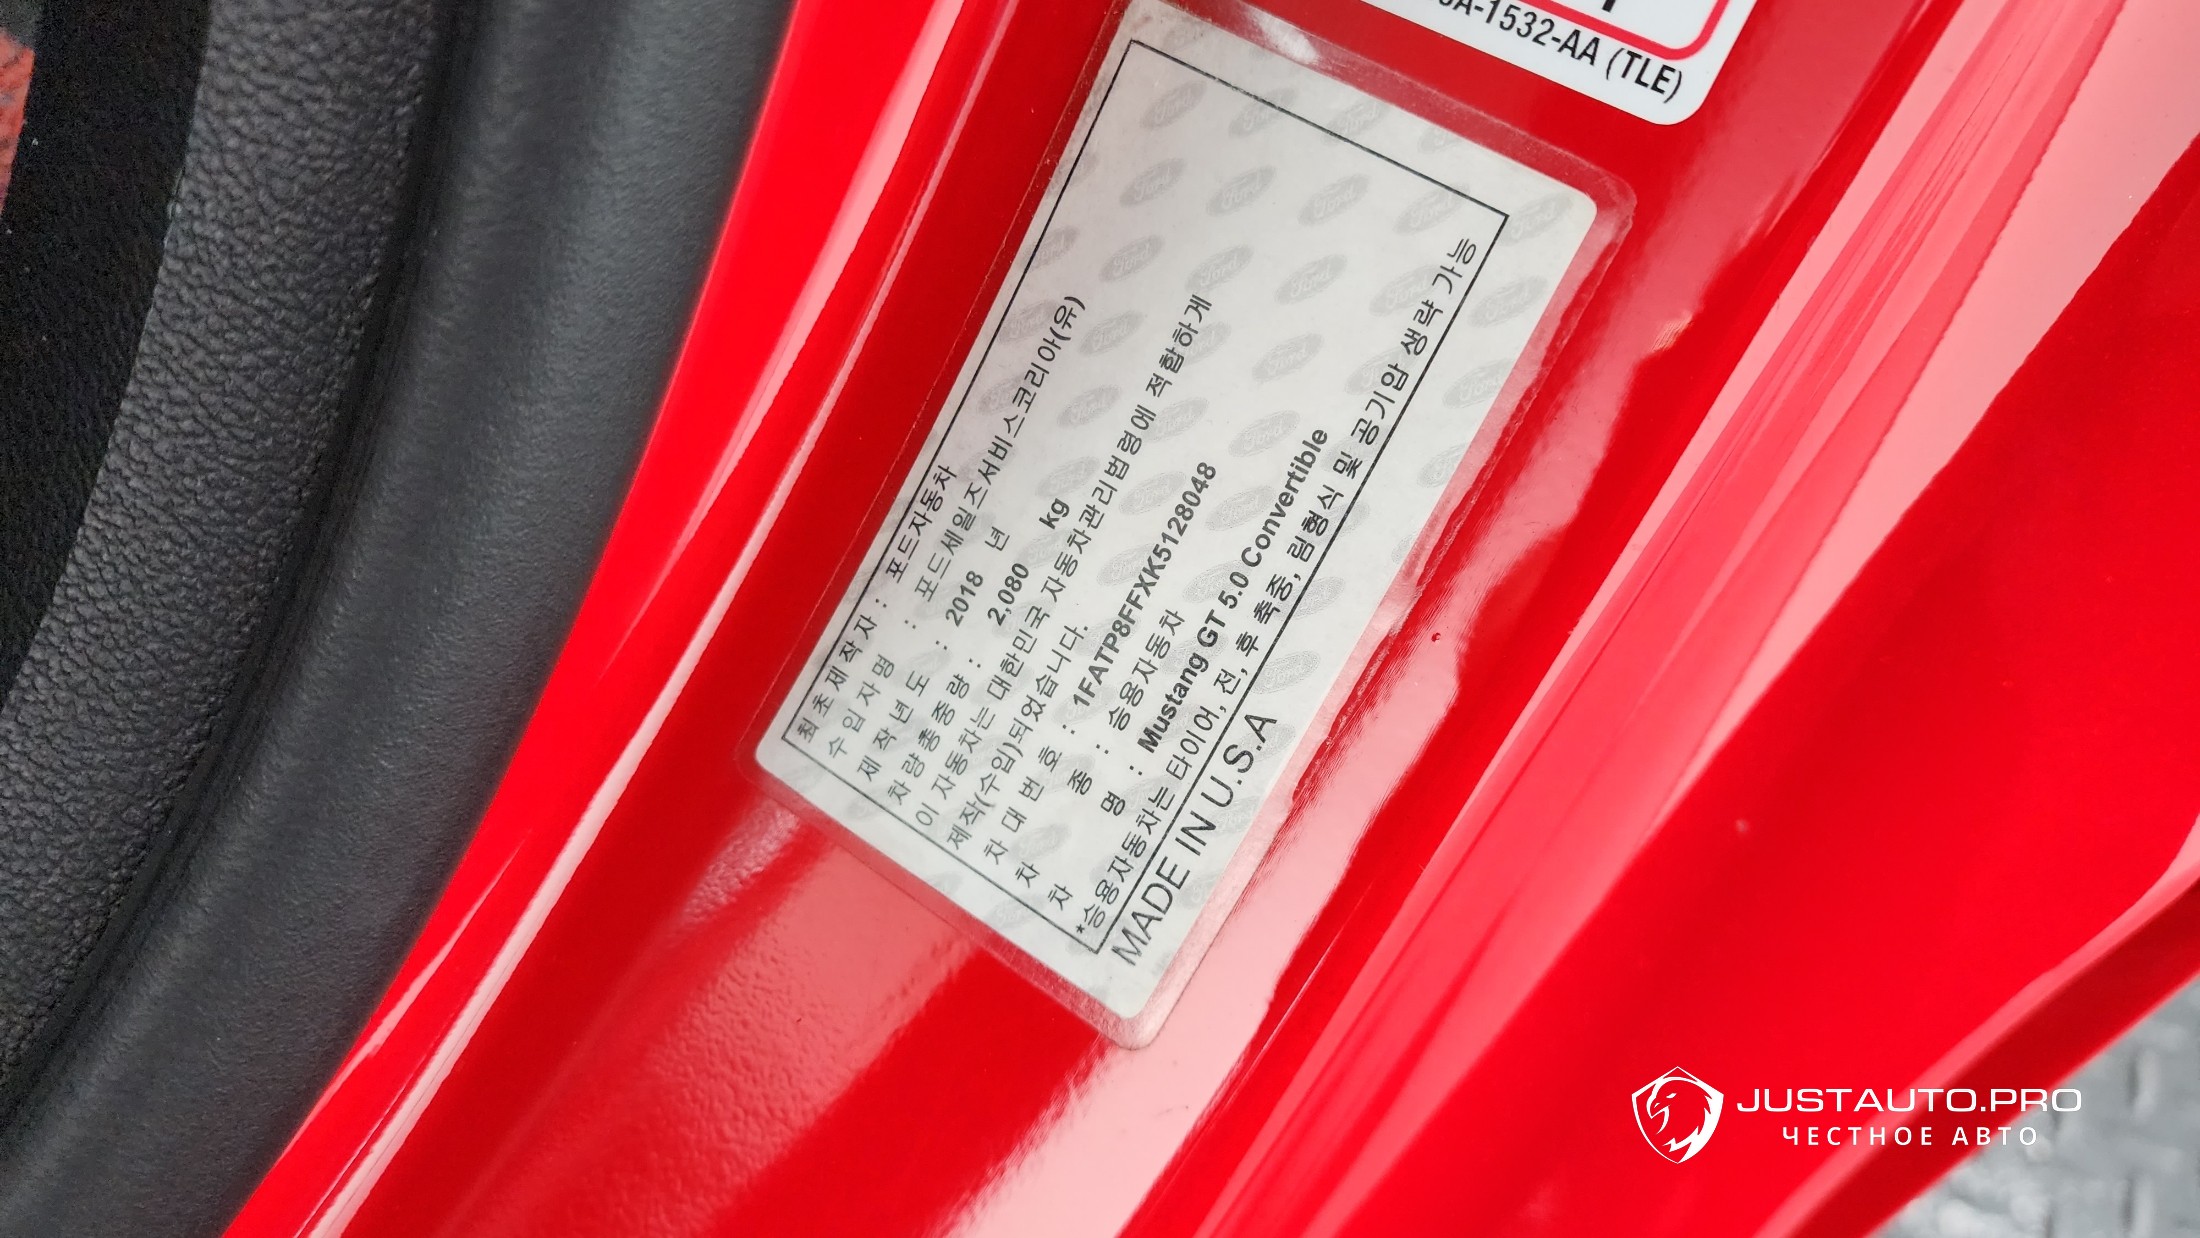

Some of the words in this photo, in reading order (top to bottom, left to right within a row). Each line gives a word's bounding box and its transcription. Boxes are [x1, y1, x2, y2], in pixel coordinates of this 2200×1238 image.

[1438, 0, 1601, 66] A-1532-AA
[1606, 47, 1682, 104] (TLE)
[884, 464, 958, 584] 포드자동차
[914, 295, 1086, 603] 포드세일즈서비스코리아(유)
[915, 802, 940, 826] 이
[931, 706, 996, 801] 자동차는
[986, 605, 1051, 701] 대한민국
[1040, 404, 1157, 604] 자동차관리법령에
[1145, 293, 1213, 398] 적합하게
[987, 562, 1030, 627] 2,080
[1038, 497, 1070, 530] kg
[1165, 705, 1227, 781] 타이어,
[1212, 667, 1248, 696] 전,
[1253, 572, 1302, 625] 축중,
[1332, 450, 1364, 480] 및
[1350, 362, 1410, 446] 공기압
[1400, 299, 1444, 357] 생략
[1431, 238, 1477, 295] 가능
[945, 570, 984, 627] 2018
[984, 526, 1011, 552] 년
[1072, 461, 1217, 707] 1FATP8FFXK5128048
[1108, 608, 1186, 732] 승용자동차
[1136, 649, 1210, 754] Mustang
[1194, 608, 1226, 651] GT
[1217, 571, 1250, 610] 5.0
[1240, 429, 1328, 568] Convertible
[1110, 855, 1191, 966] MADE
[1174, 810, 1217, 857] IN
[1200, 714, 1278, 808] U.S.A
